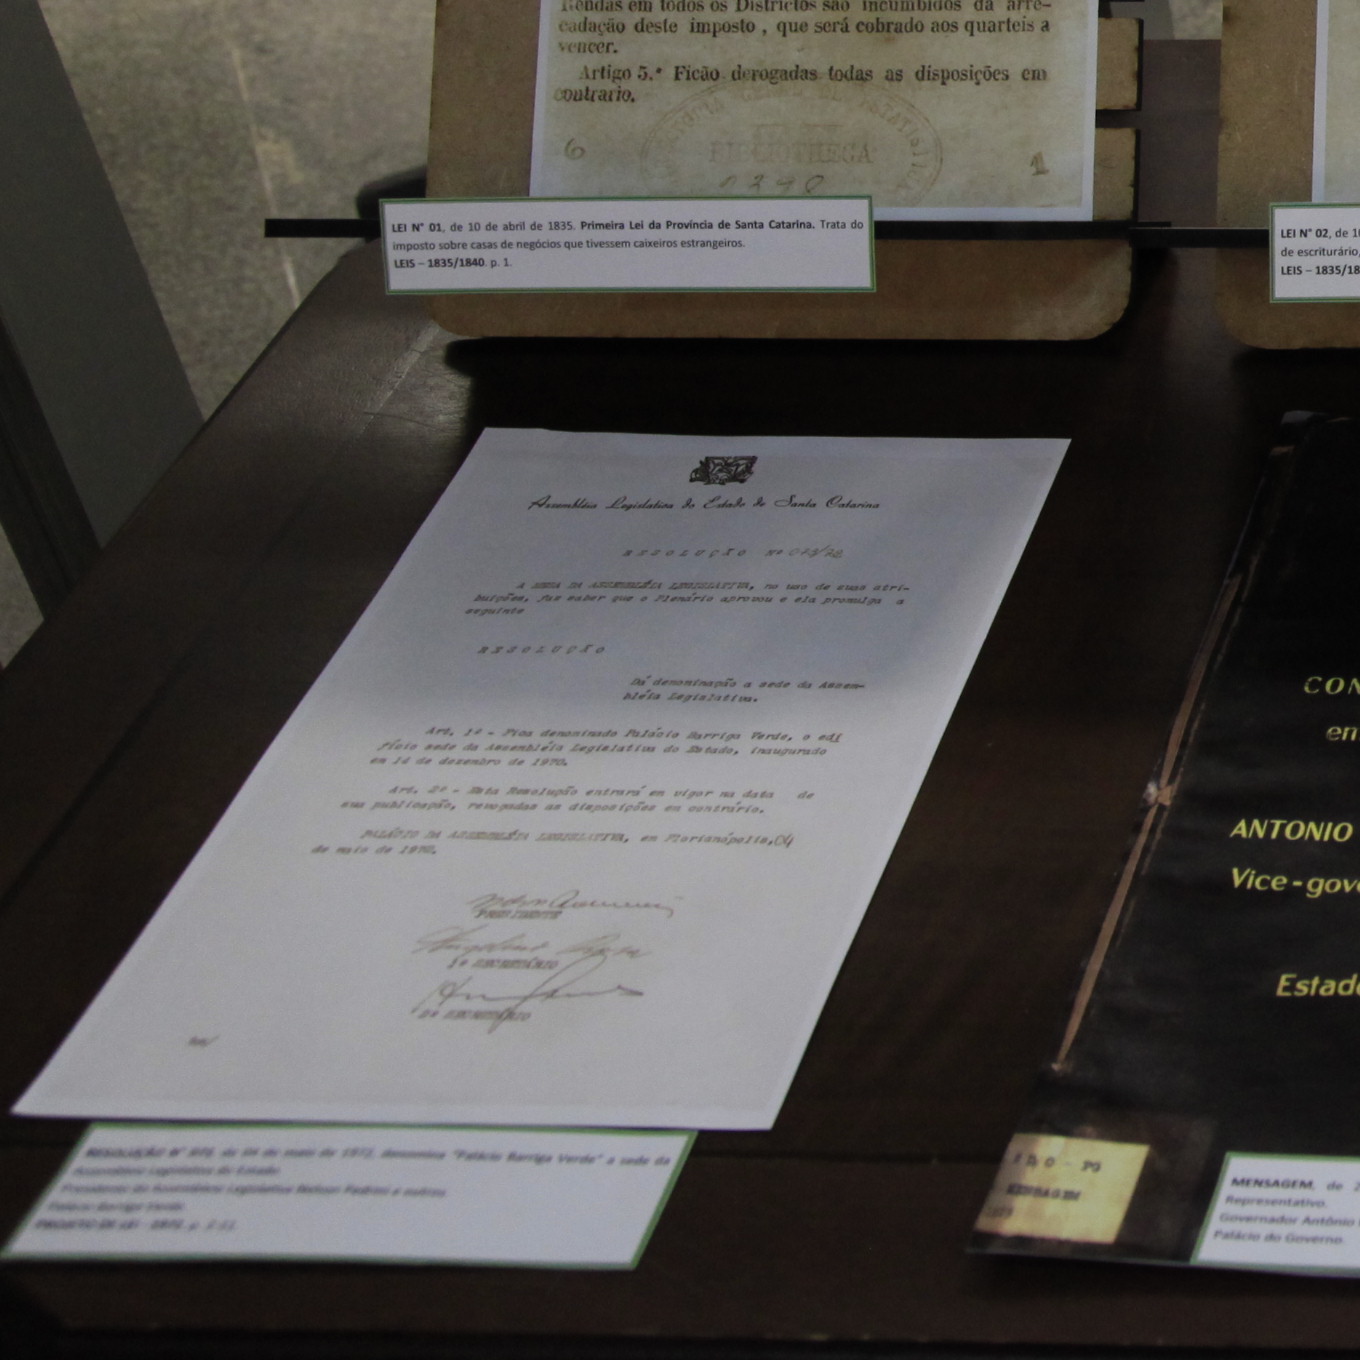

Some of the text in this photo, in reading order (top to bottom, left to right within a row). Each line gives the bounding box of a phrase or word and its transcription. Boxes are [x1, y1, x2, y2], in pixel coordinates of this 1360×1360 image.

[392, 223, 407, 233] LEI
[429, 222, 446, 233] 01,
[450, 222, 463, 232] de
[468, 222, 481, 232] 10
[485, 221, 498, 232] de
[502, 221, 526, 231] abril
[530, 221, 543, 231] de
[580, 220, 625, 230] Primeira
[629, 220, 644, 230] Lei
[648, 220, 661, 230] da
[666, 219, 713, 230] Província
[717, 219, 731, 230] de
[735, 220, 764, 229] Santa
[820, 219, 846, 229] Trata
[850, 219, 864, 230] do
[1281, 229, 1296, 239] LEI
[1315, 228, 1332, 239] 02,
[1335, 228, 1349, 238] de
[394, 259, 416, 269] LEIS
[1230, 819, 1353, 842] ANTONIO
[1231, 1177, 1314, 1190] MENSAGEM,
[1326, 1180, 1344, 1191] de
